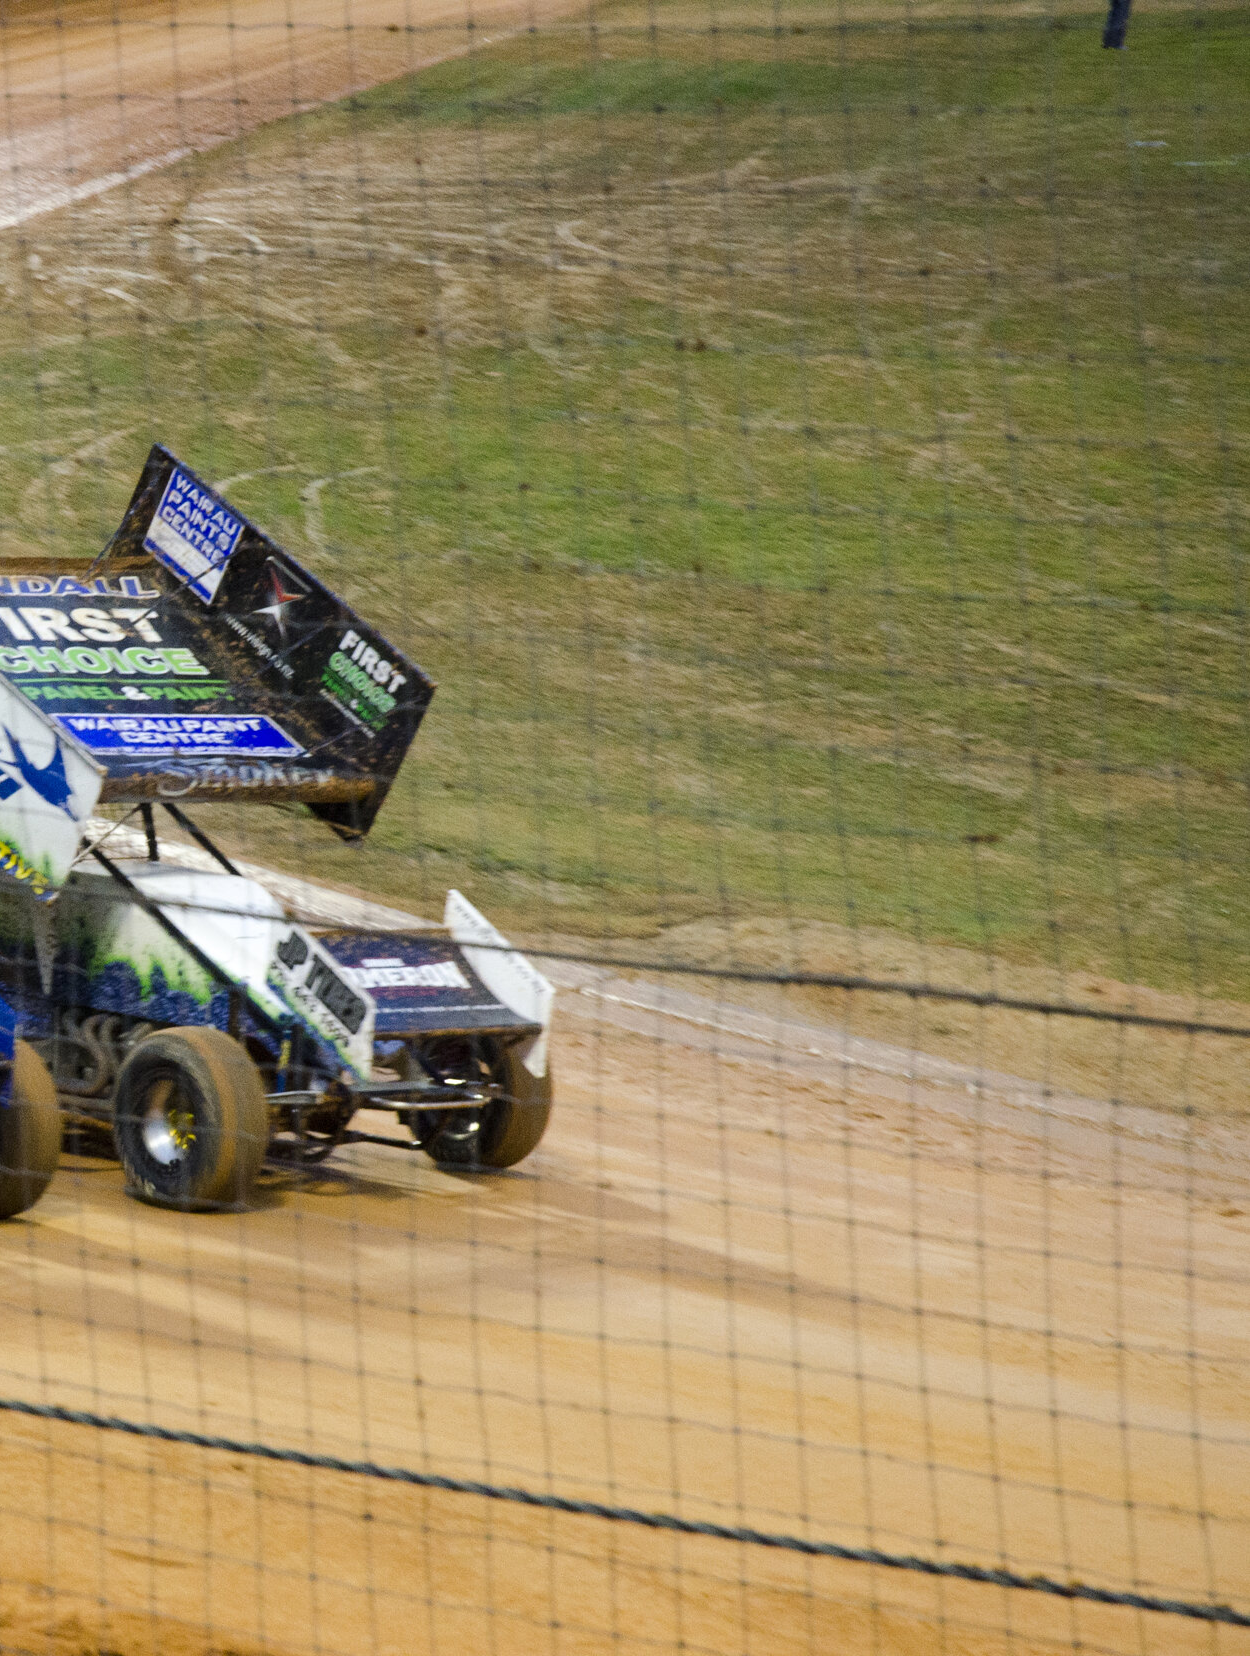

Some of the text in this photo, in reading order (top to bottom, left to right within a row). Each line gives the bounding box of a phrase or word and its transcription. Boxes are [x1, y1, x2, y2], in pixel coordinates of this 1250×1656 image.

[176, 474, 238, 536] WAIRAU
[18, 686, 126, 700] PANEL
[121, 685, 151, 700] &
[328, 651, 398, 713] CHOICE
[338, 629, 407, 694] FIRST
[118, 731, 233, 745] CENTRE
